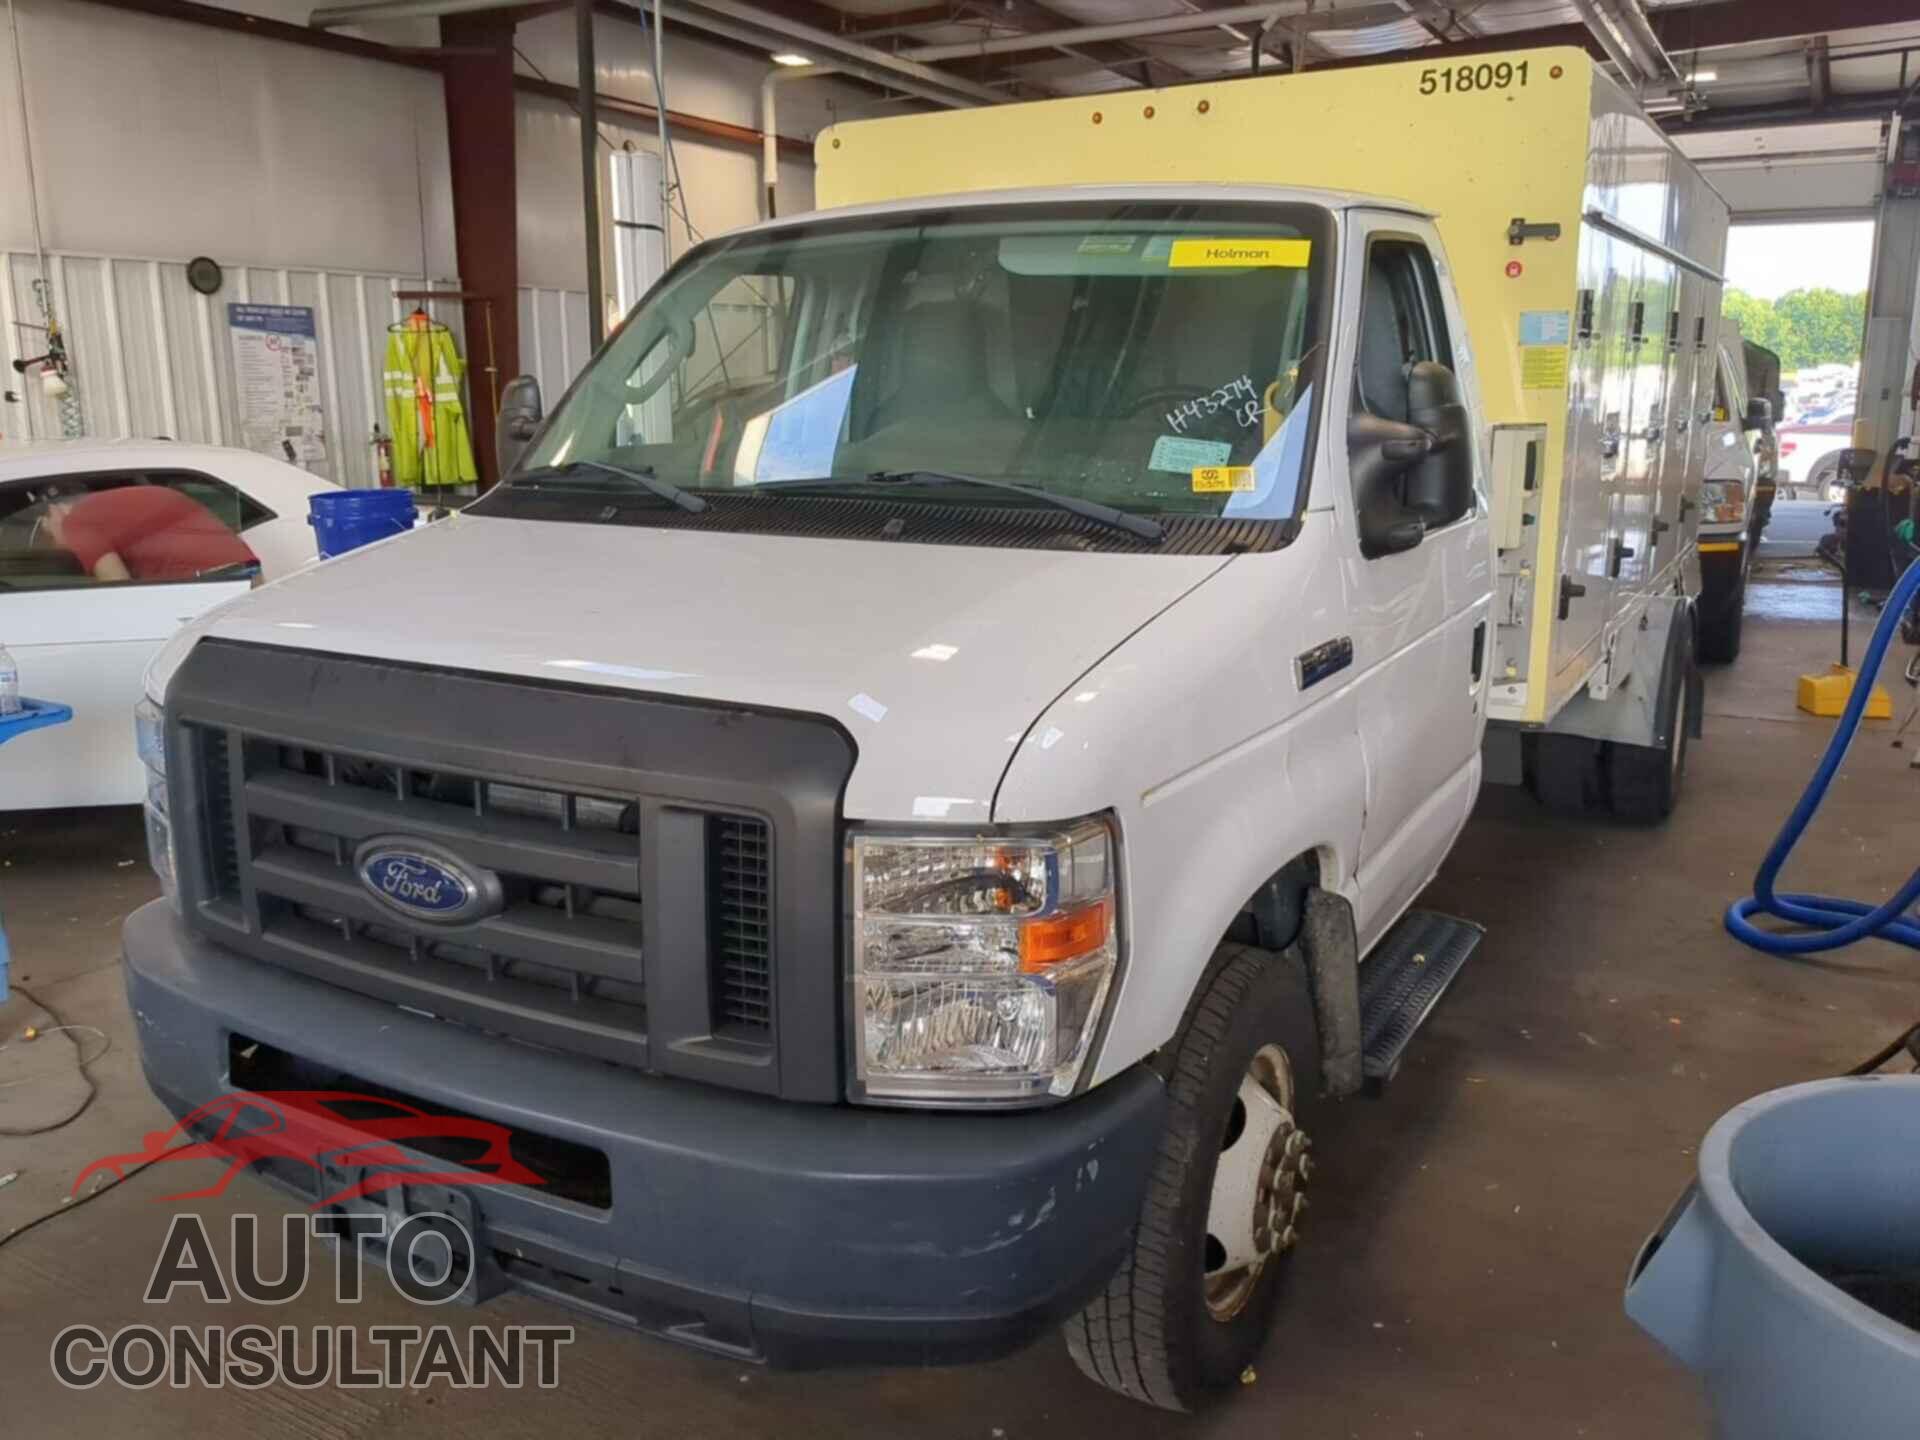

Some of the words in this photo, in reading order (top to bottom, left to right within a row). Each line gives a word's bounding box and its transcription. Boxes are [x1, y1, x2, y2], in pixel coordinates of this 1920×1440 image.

[1419, 60, 1529, 95] 518091
[1205, 246, 1271, 260] Holman
[383, 860, 442, 904] Ford
